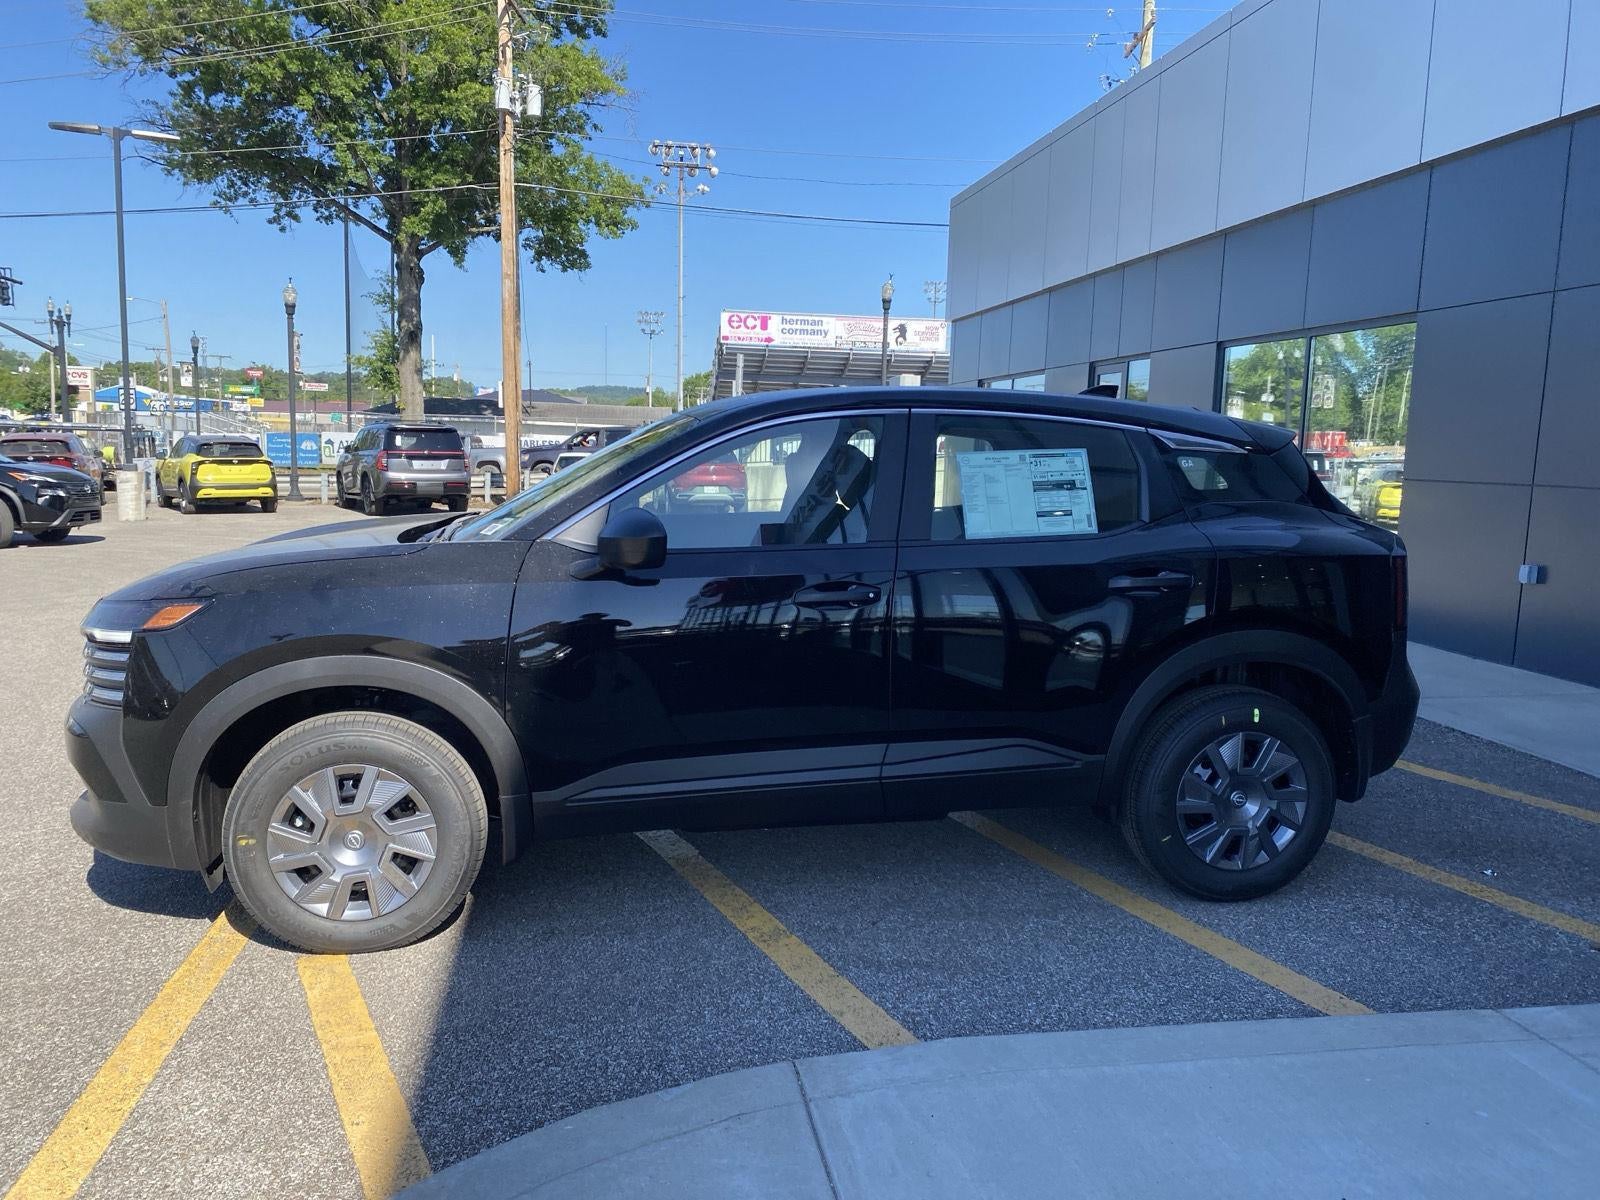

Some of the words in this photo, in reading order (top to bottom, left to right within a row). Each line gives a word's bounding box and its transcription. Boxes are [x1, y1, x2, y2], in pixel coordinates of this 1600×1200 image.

[781, 316, 823, 327] herman
[781, 328, 829, 338] cormany
[71, 371, 88, 379] CVS
[152, 404, 165, 412] 60
[279, 743, 345, 774] SOLUS
